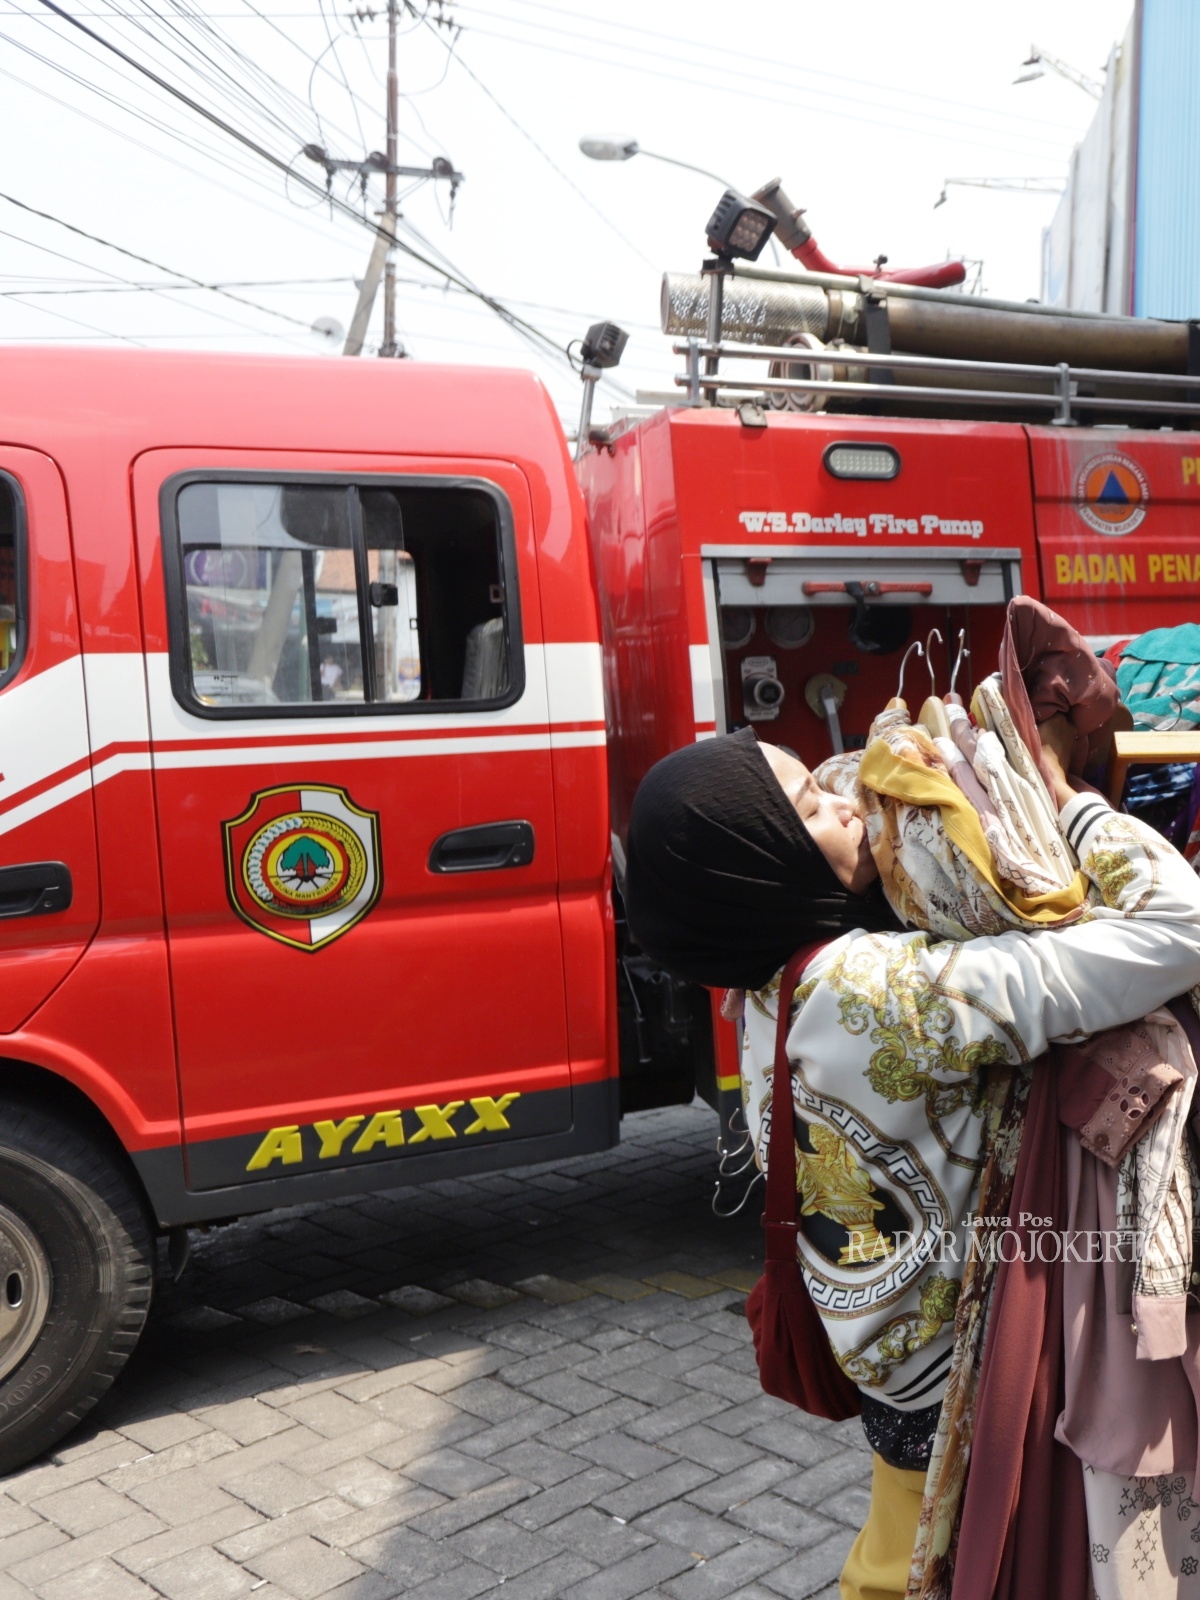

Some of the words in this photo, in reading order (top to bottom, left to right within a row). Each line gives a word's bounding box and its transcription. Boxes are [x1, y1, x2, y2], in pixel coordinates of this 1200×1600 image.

[869, 513, 919, 535] Fire
[921, 515, 984, 539] Pump
[1055, 554, 1136, 584] BADAN
[246, 1092, 521, 1171] AYAXX
